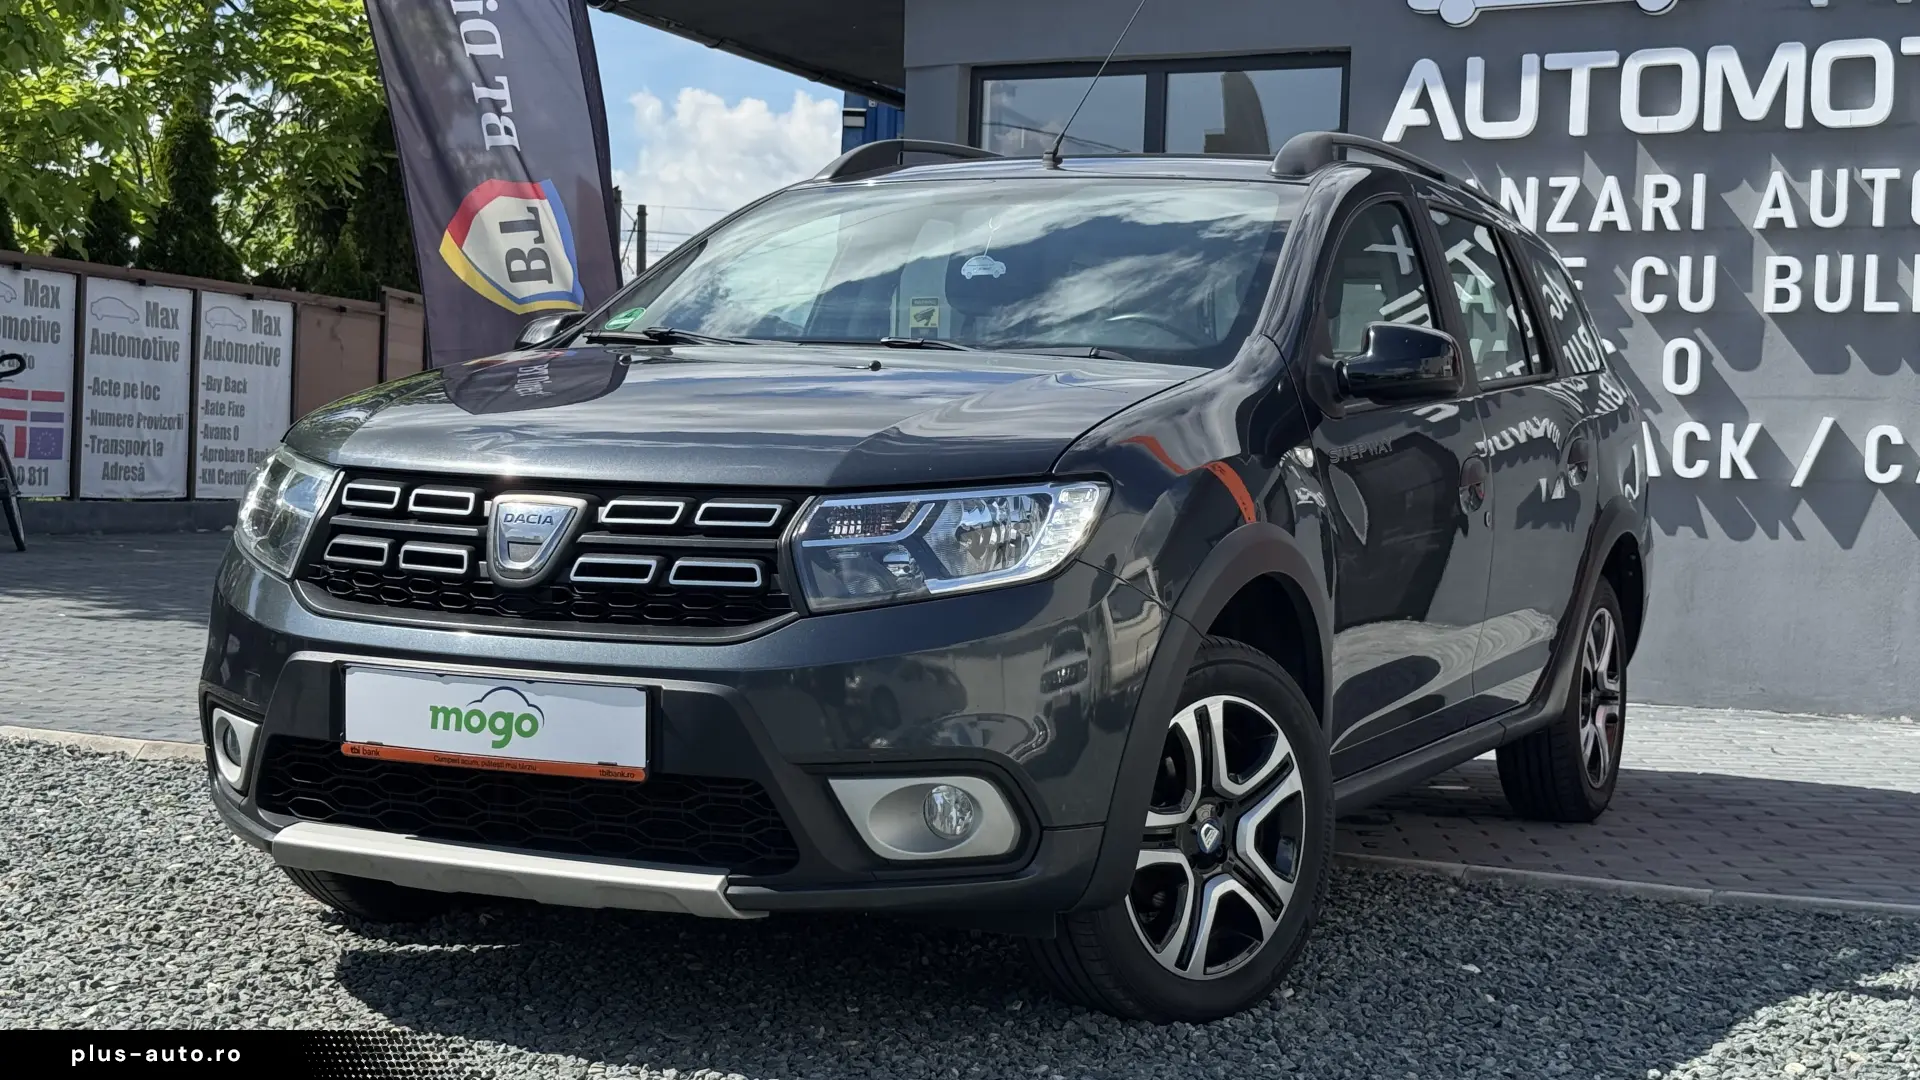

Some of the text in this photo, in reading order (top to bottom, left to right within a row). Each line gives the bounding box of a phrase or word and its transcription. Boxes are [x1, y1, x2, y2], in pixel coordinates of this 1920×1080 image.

[1382, 36, 1920, 142] AUTOMO
[472, 75, 521, 152] BT
[1753, 168, 1920, 229] AUT
[499, 206, 554, 285] BT
[24, 278, 61, 309] Max
[1630, 255, 1717, 313] CU
[1763, 253, 1920, 313] BUL
[0, 315, 61, 344] motive
[145, 301, 180, 330] Max
[252, 309, 282, 337] Max
[90, 328, 180, 362] Automotive
[203, 335, 281, 367] Automotive
[88, 377, 161, 401] -Acte pe loc
[224, 376, 248, 394] Back
[86, 409, 184, 430] -Numere Provizorii
[228, 401, 245, 418] Fixe
[85, 434, 164, 457] -Transport la
[1329, 436, 1393, 464] STEPWAY
[1790, 416, 1835, 488] /
[1864, 424, 1920, 484] C
[28, 466, 49, 487] 811
[101, 461, 145, 482] Adresă
[217, 468, 250, 486] Certifi
[503, 513, 554, 526] DACIA
[429, 704, 539, 749] mogo
[350, 744, 380, 757] tbi bank
[505, 761, 517, 770] mai
[599, 769, 635, 779] tbibank.ro
